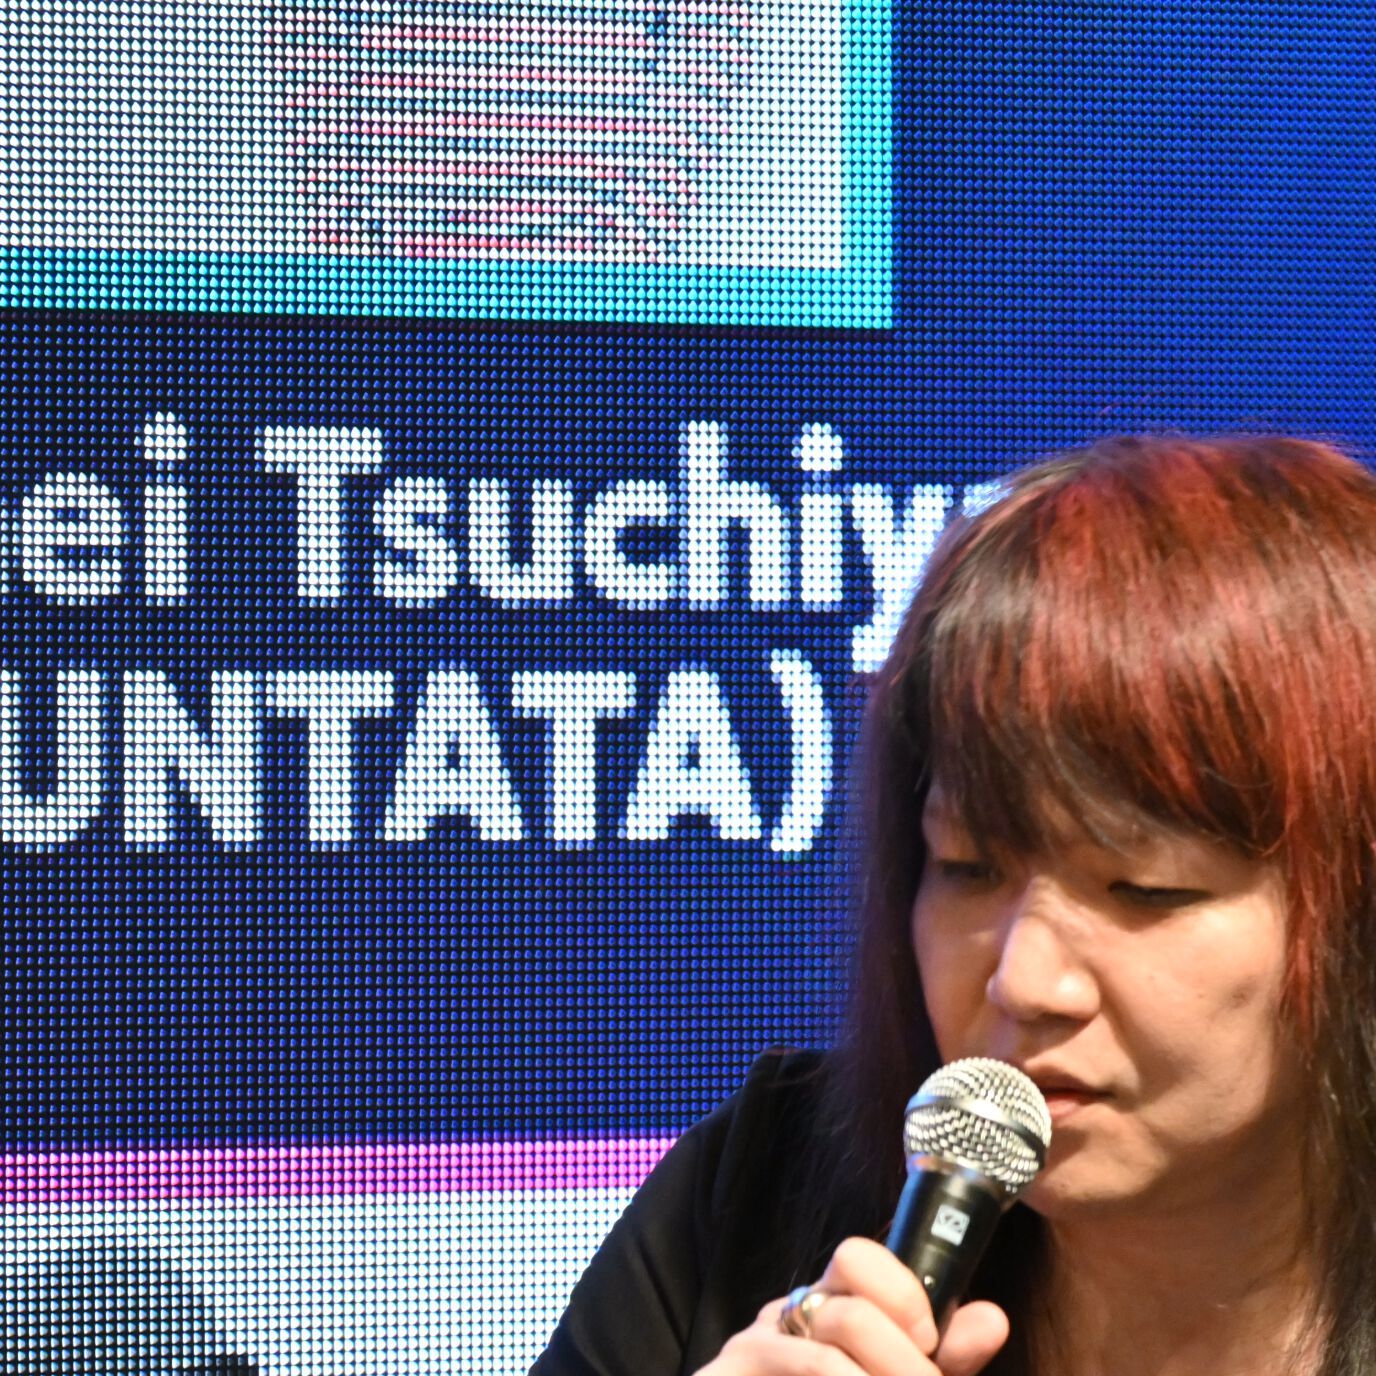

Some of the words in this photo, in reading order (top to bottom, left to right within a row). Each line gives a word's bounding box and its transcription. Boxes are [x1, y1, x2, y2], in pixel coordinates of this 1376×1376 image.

[0, 411, 189, 606] ei
[262, 418, 1010, 674] Tsuchiy
[0, 650, 834, 854] UNTATA)
